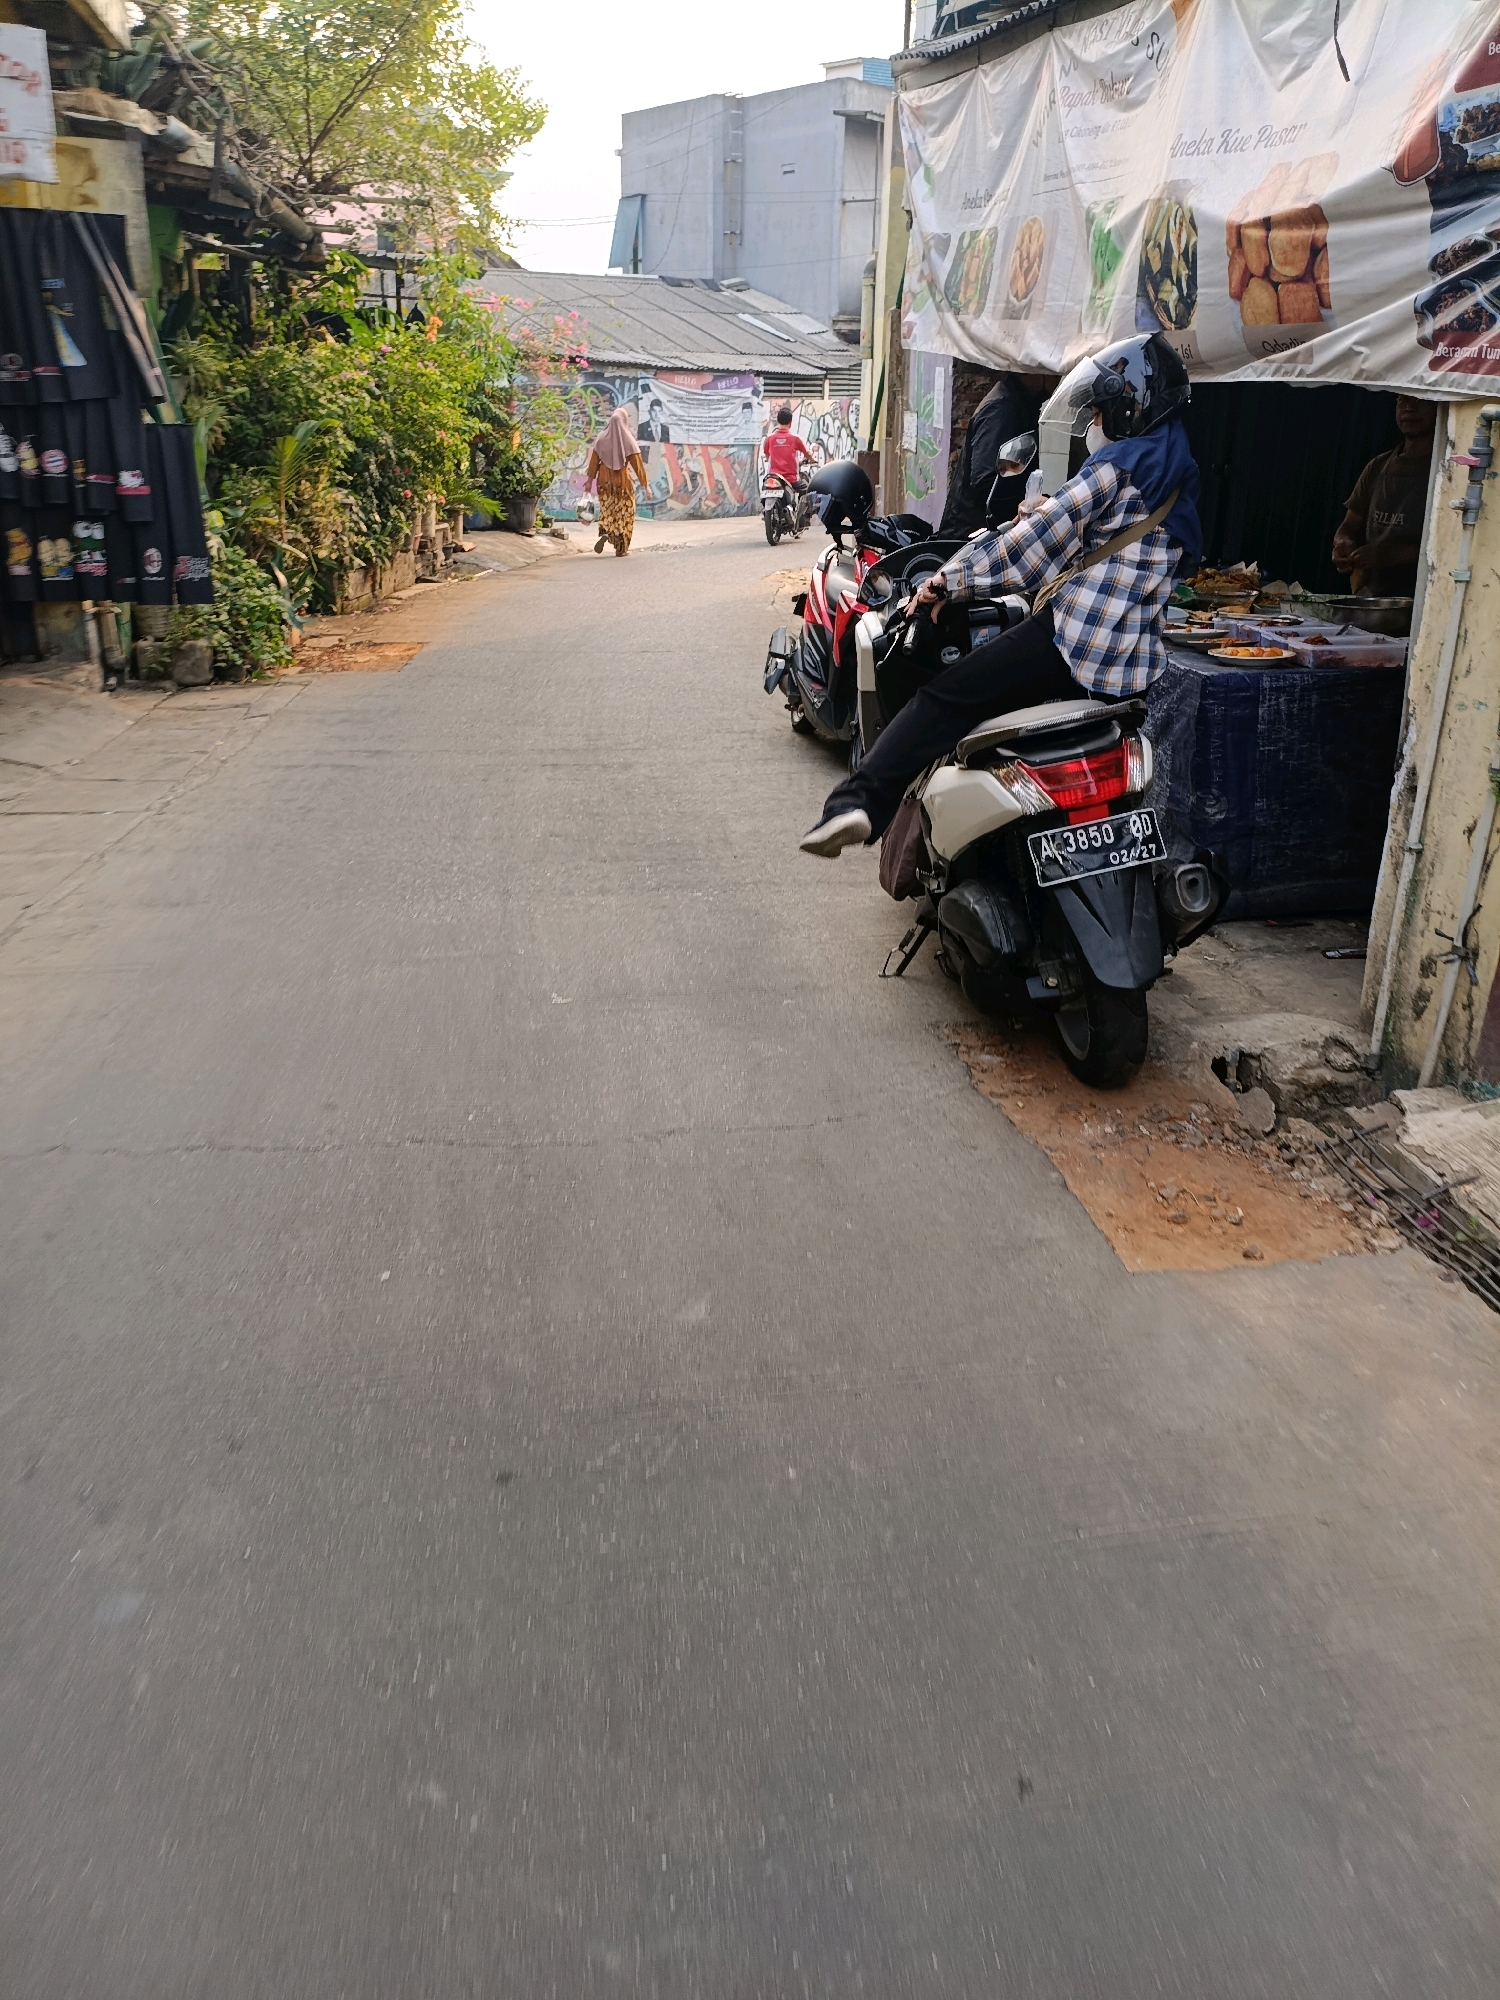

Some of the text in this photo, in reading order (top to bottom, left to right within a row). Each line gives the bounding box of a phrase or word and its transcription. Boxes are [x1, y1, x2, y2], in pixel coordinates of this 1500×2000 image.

[1169, 122, 1308, 159] Aneka Kue Pasar
[717, 376, 739, 390] HELLO
[1062, 823, 1115, 853] 3850
